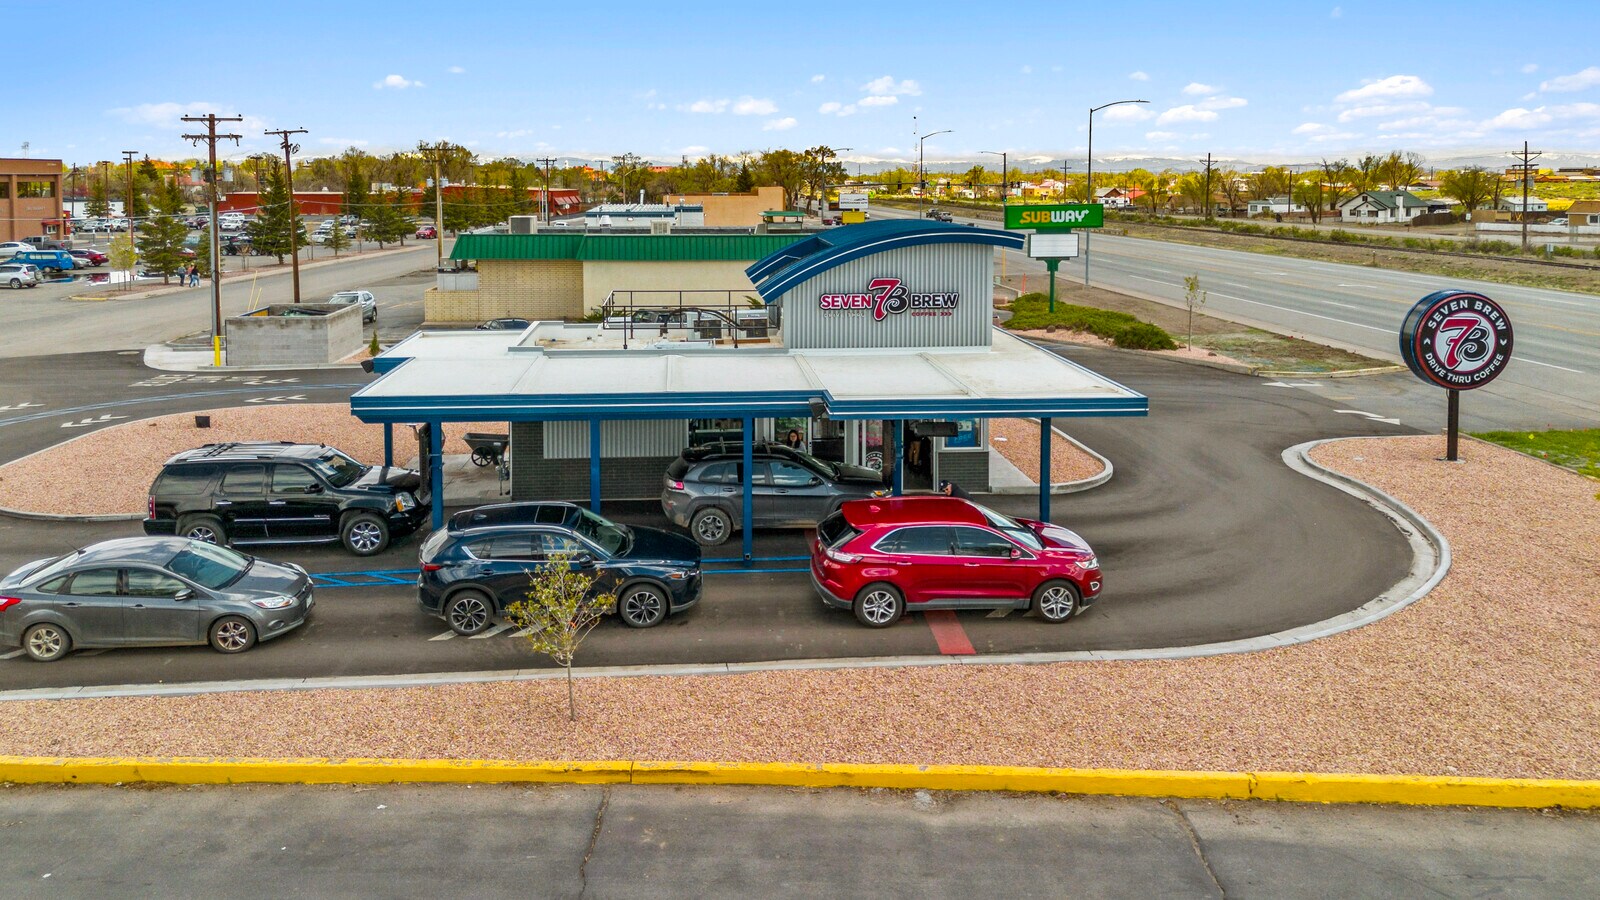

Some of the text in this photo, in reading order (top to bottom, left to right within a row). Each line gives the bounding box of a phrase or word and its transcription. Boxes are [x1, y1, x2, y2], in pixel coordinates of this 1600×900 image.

[1020, 209, 1089, 224] SUBWAY
[820, 293, 873, 309] SEVEN
[910, 293, 959, 309] BREW
[1428, 300, 1507, 330] SEVEN BREW
[1425, 353, 1504, 383] DRIVE THRU COFFEE
